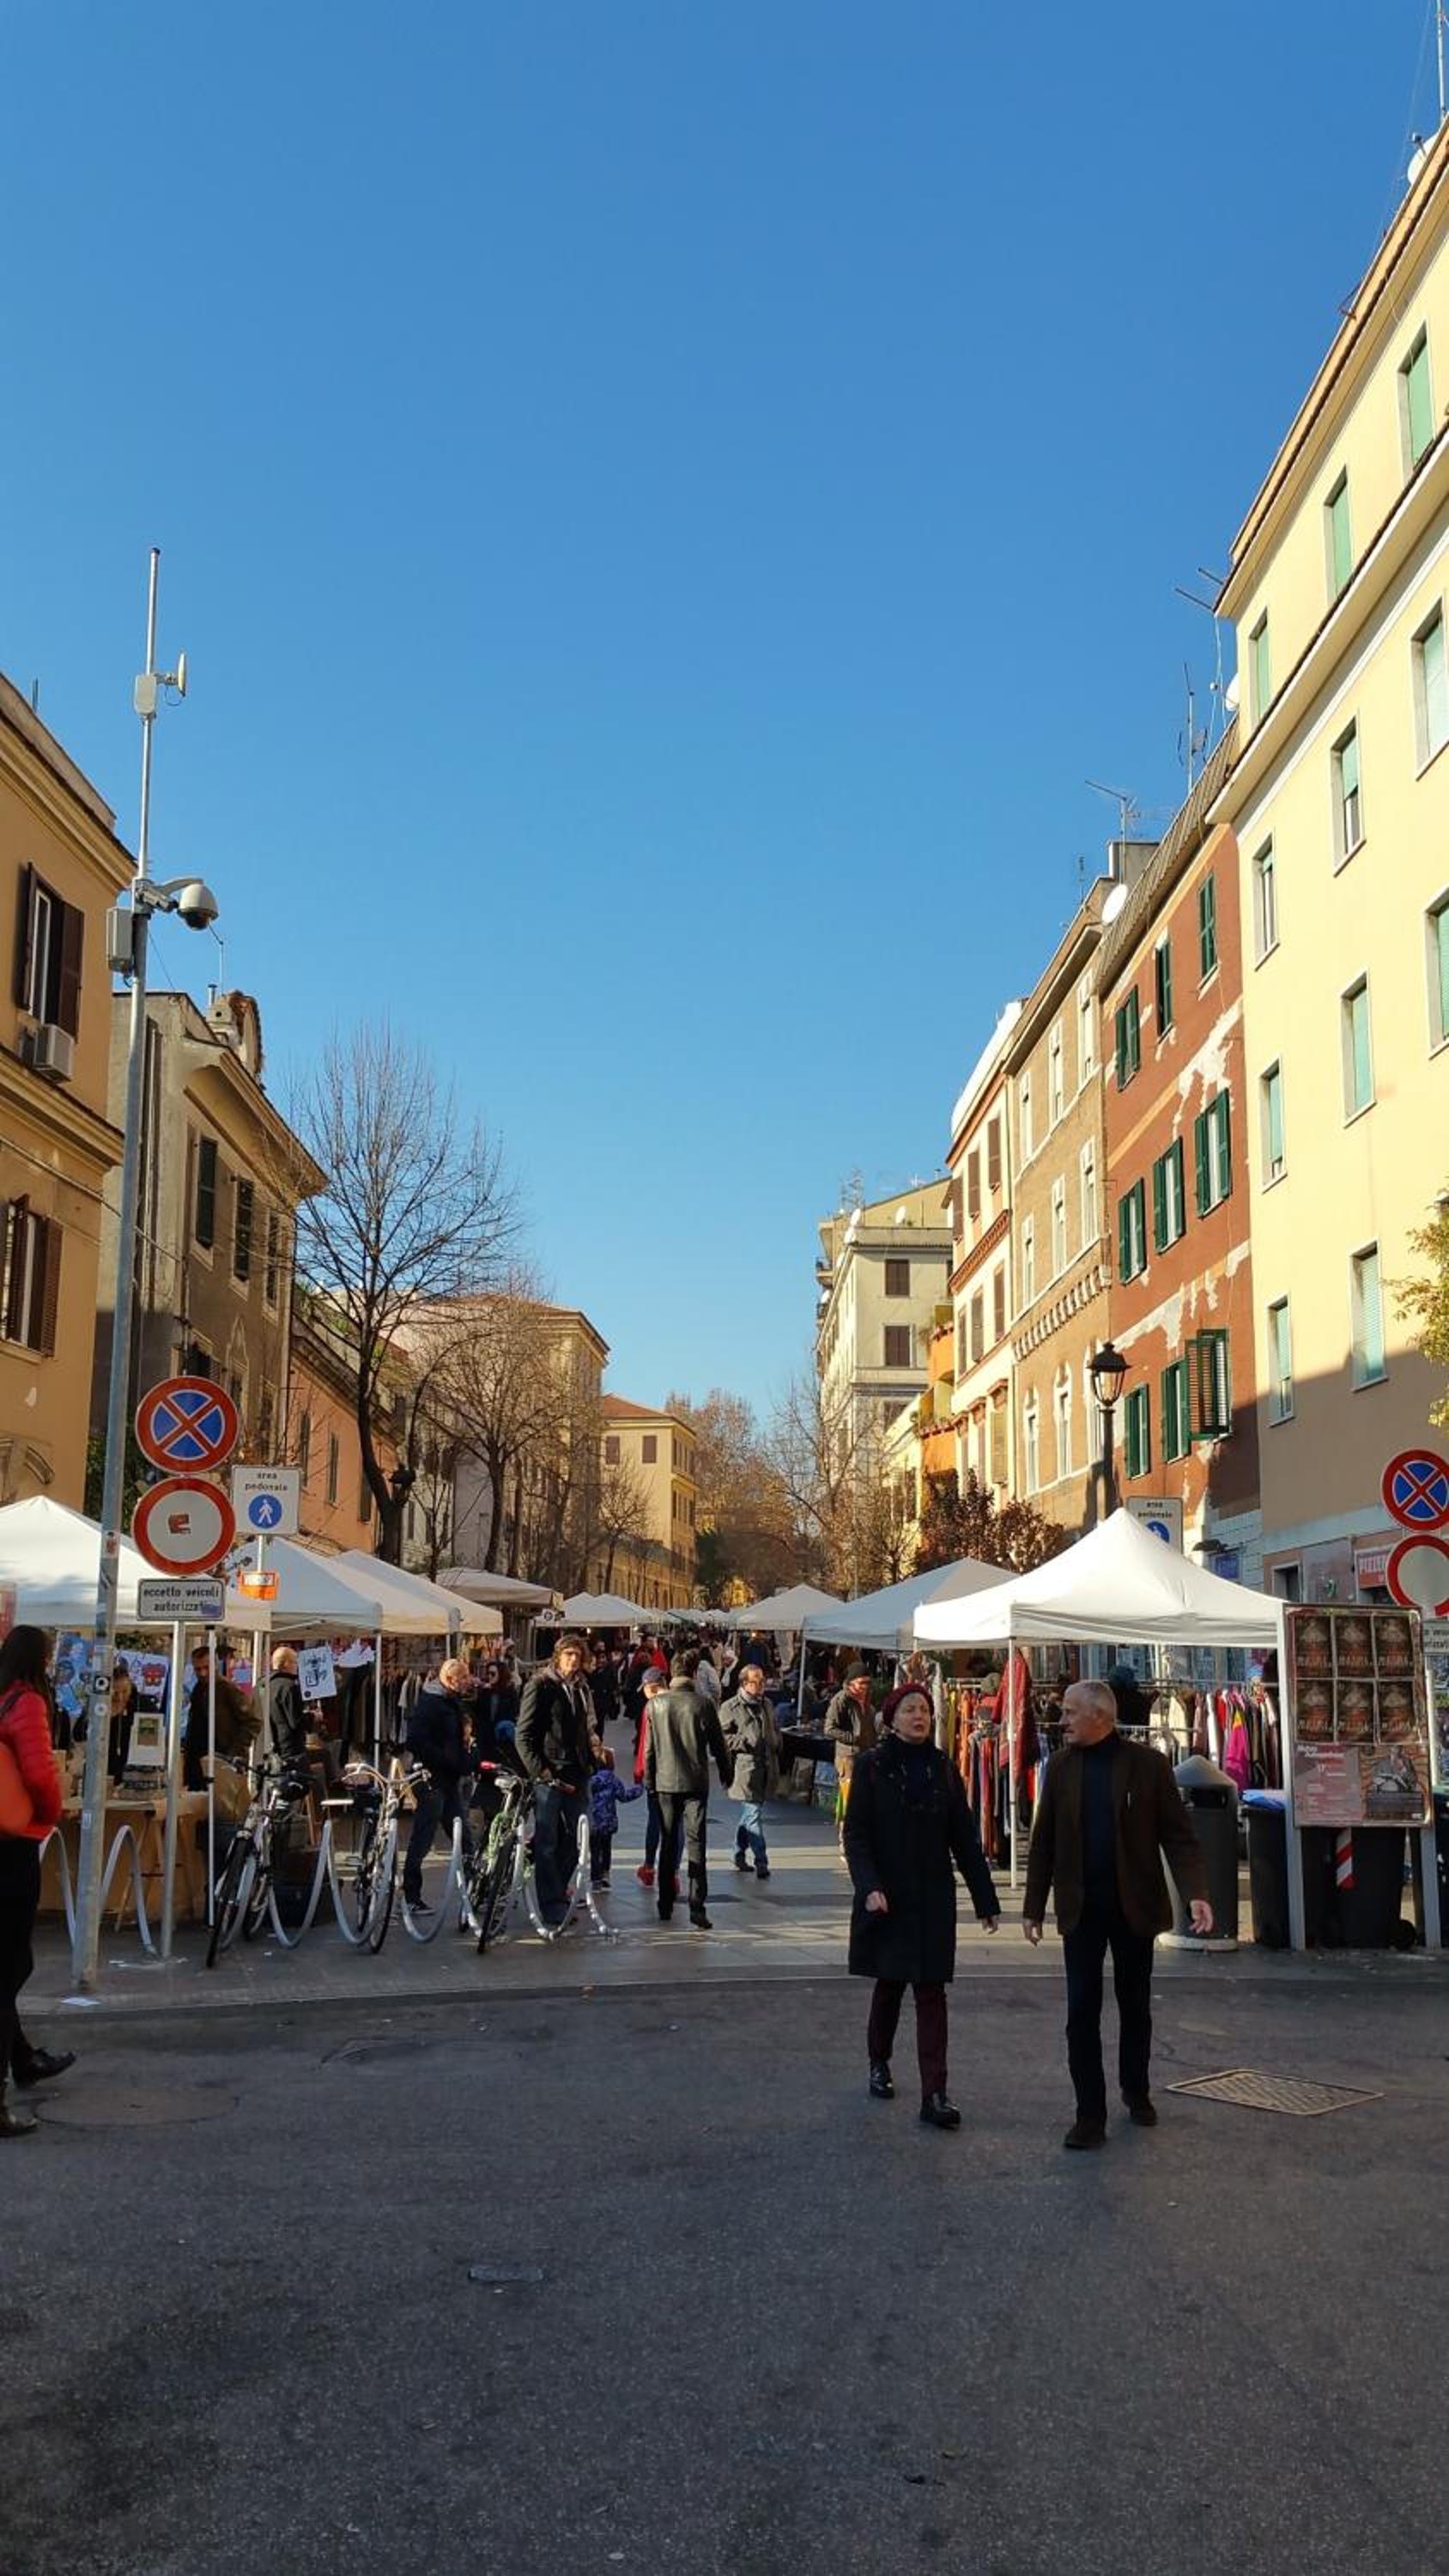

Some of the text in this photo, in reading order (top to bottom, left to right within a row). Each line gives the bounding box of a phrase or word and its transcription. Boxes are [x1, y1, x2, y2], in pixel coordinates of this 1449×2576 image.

[245, 1482, 288, 1492] pedonale
[143, 1586, 220, 1597] eccetto veicoli
